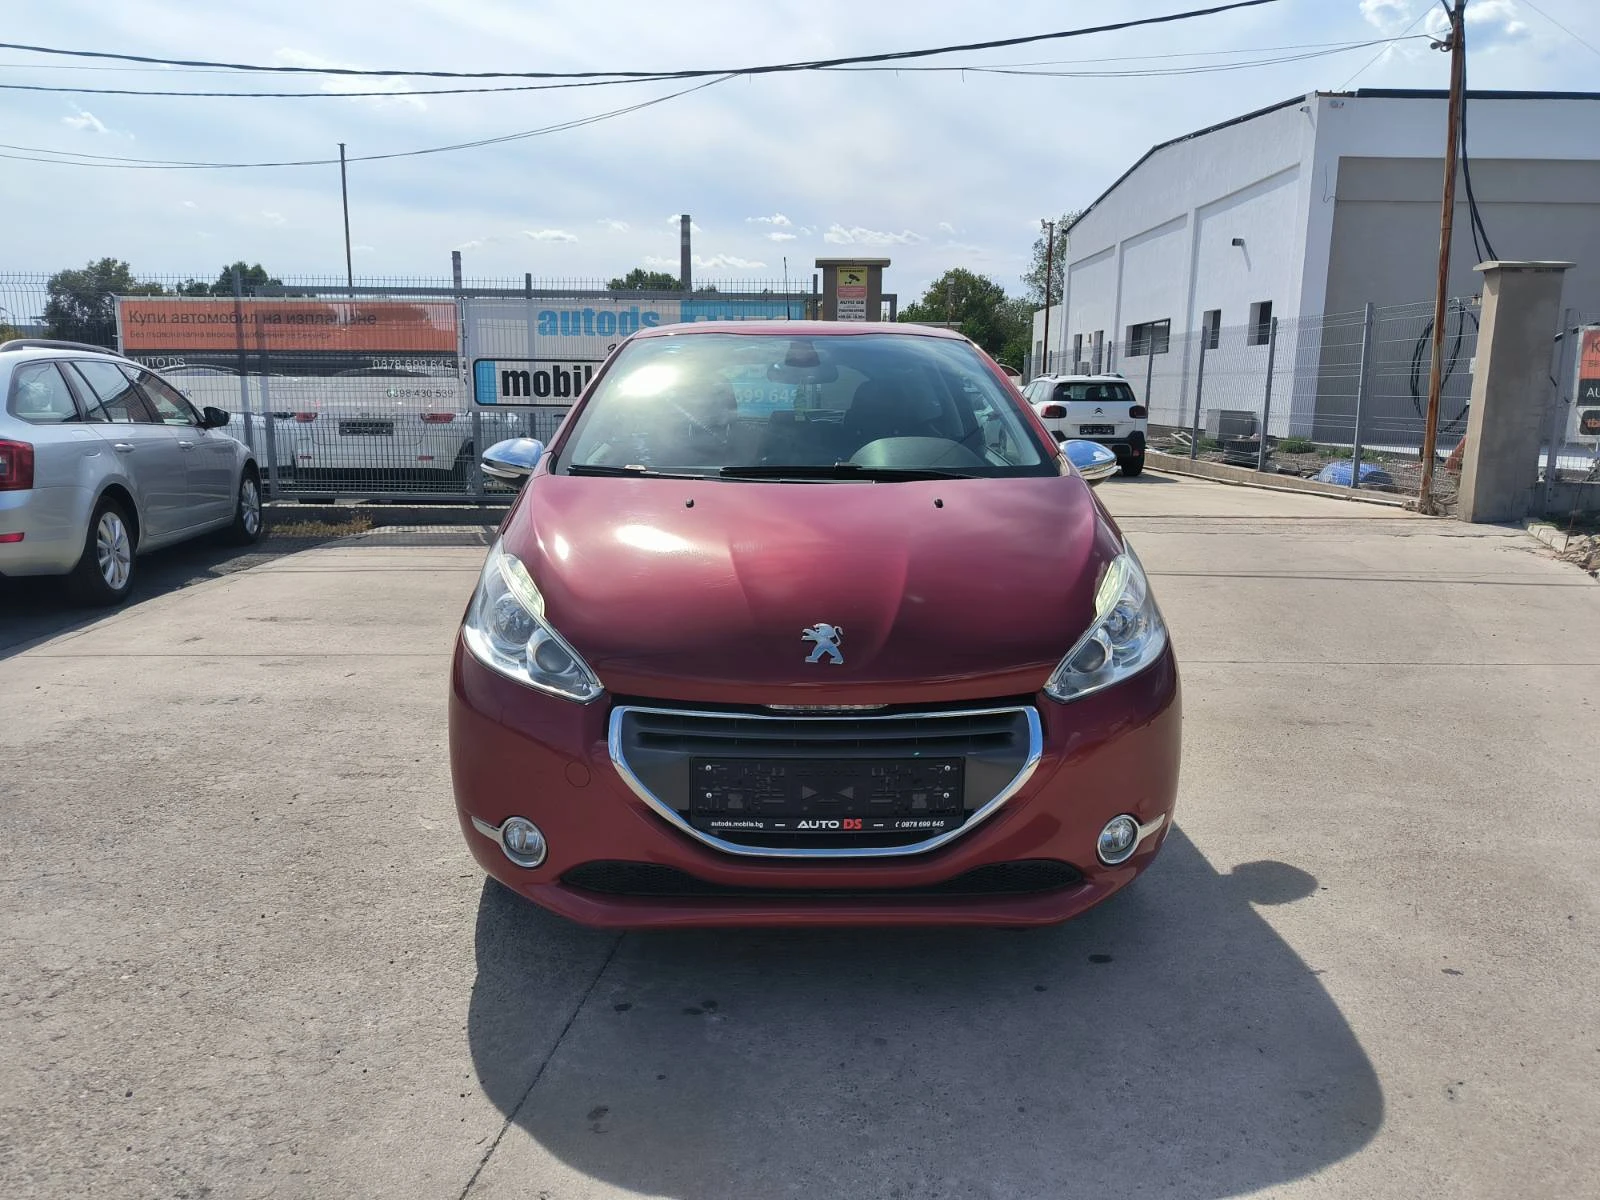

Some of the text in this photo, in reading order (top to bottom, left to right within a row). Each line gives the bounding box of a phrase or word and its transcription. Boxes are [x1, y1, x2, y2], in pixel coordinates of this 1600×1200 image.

[129, 310, 166, 326] Купи
[171, 311, 258, 324] автомобил
[263, 313, 281, 324] на
[538, 307, 660, 337] autods
[372, 359, 401, 370] 0878
[405, 359, 427, 370] 699
[414, 389, 432, 398] 430
[797, 820, 840, 829] AUTO
[843, 818, 863, 830] DS
